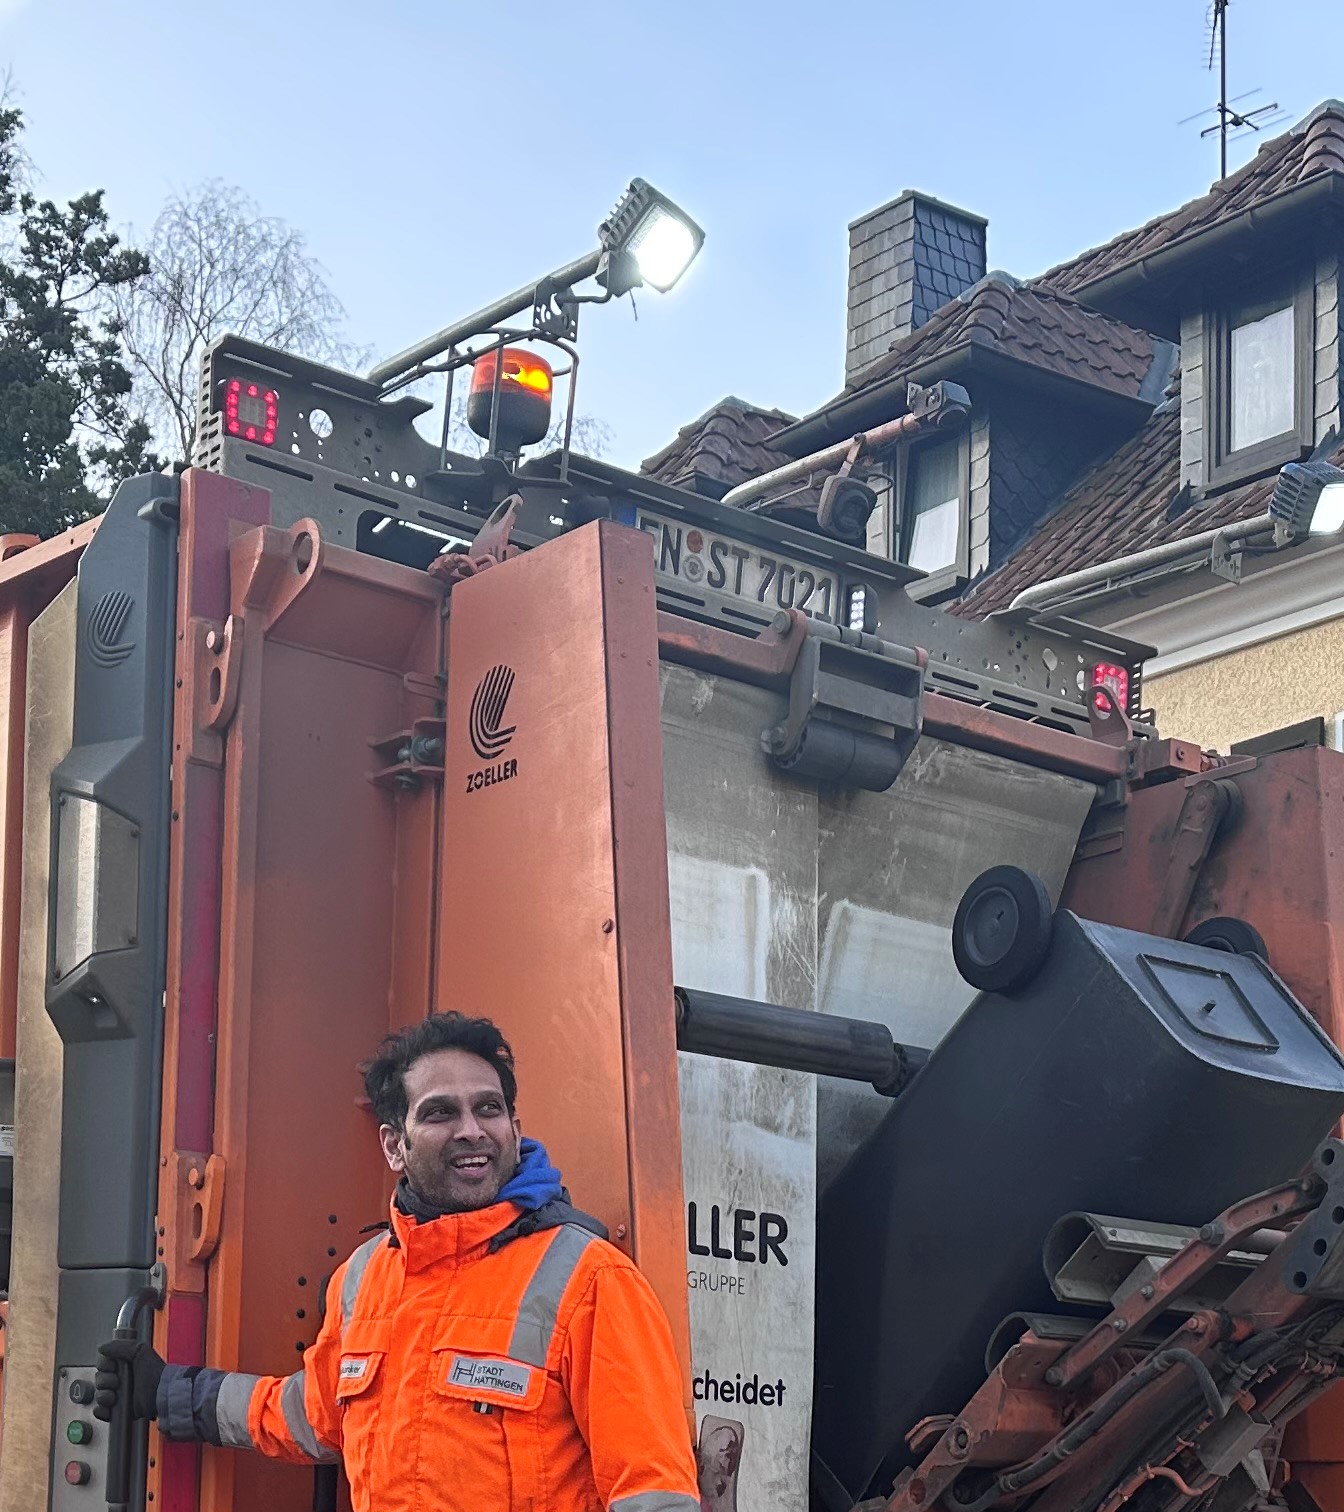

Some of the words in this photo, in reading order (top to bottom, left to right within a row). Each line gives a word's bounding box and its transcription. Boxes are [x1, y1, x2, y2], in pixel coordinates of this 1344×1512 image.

[707, 540, 750, 595] ST
[757, 556, 833, 624] 7021
[466, 758, 518, 793] ZOELLER
[688, 1201, 788, 1266] LLER
[687, 1270, 745, 1295] GRUPPE
[474, 1377, 523, 1392] HATTINGEN
[477, 1365, 504, 1377] STADT
[692, 1368, 786, 1407] cheidet
